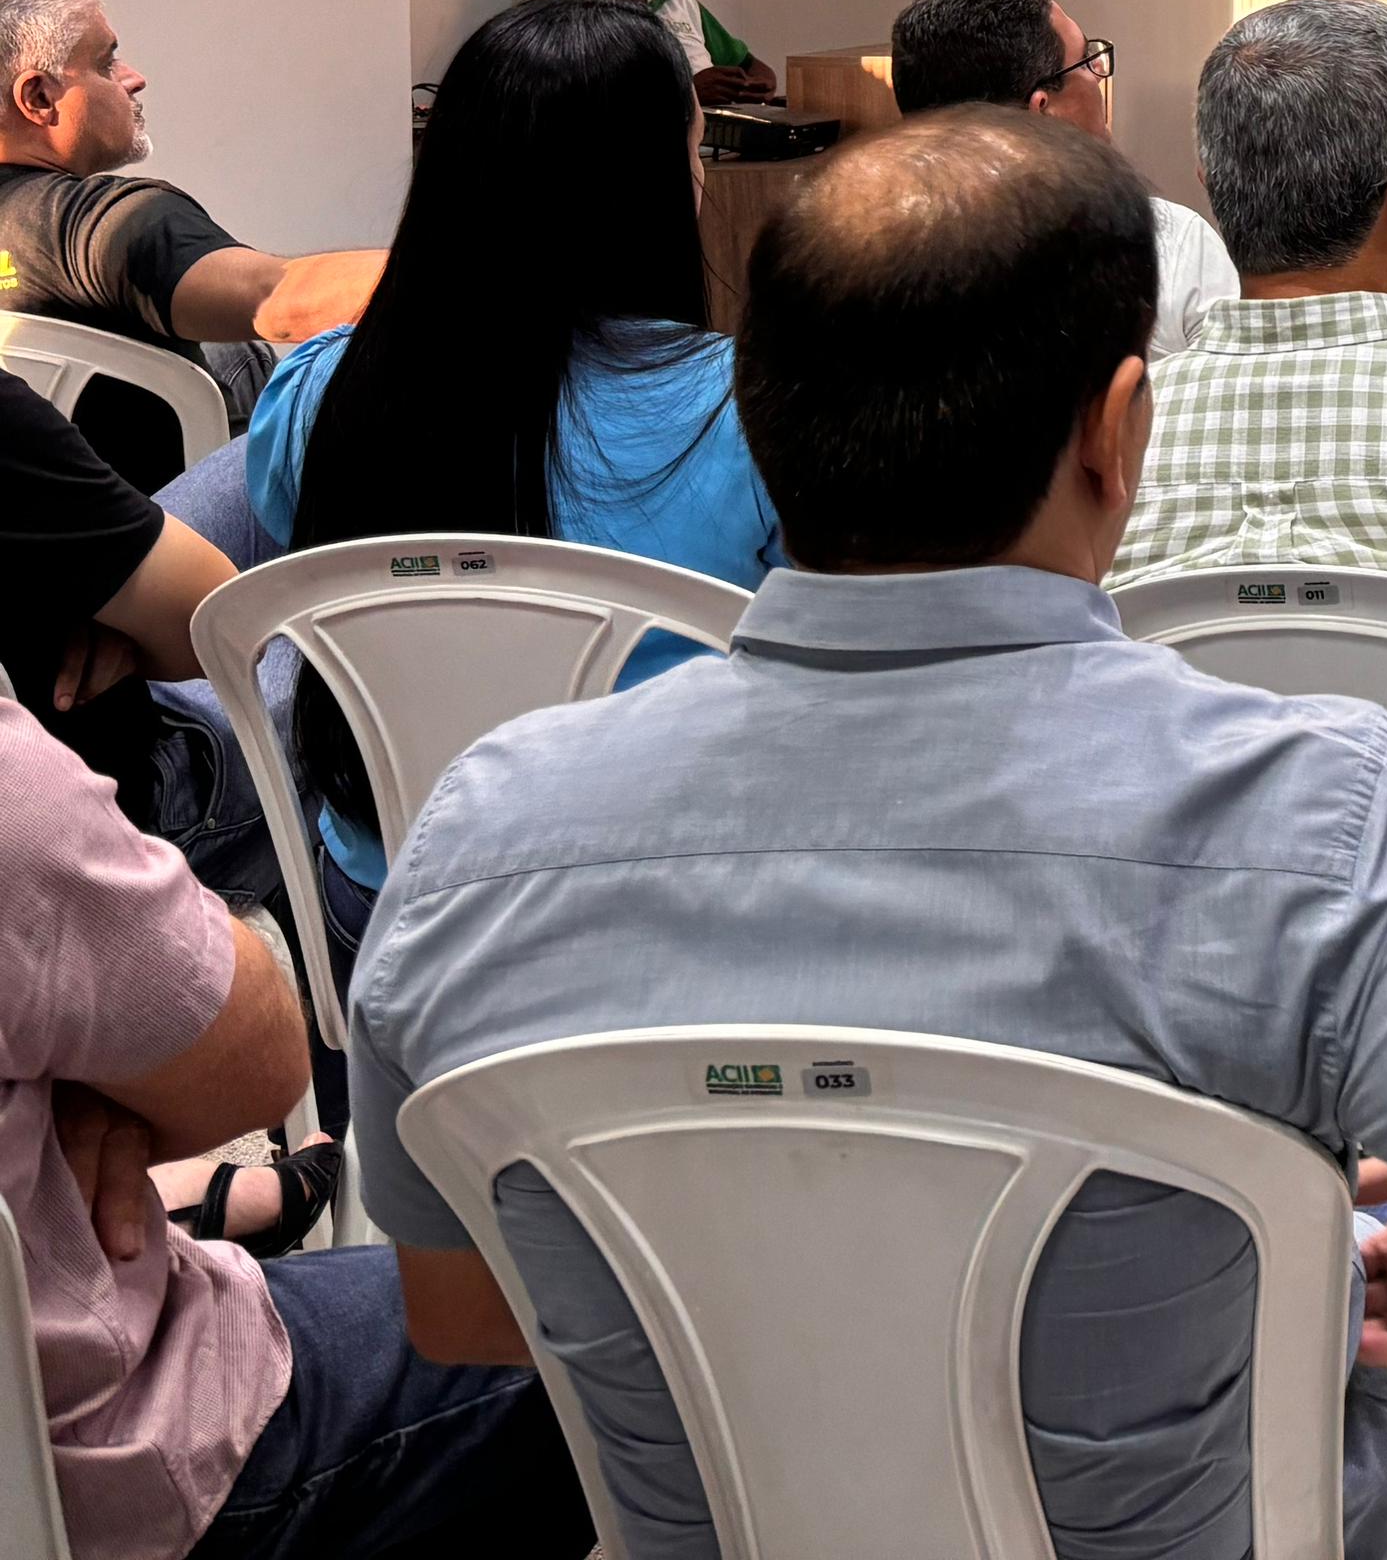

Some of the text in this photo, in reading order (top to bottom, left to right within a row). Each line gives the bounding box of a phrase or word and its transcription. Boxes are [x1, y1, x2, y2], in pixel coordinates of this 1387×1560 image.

[390, 557, 488, 570] ACII 062
[1238, 584, 1325, 601] ACII 011
[705, 1064, 855, 1089] ACII 033
